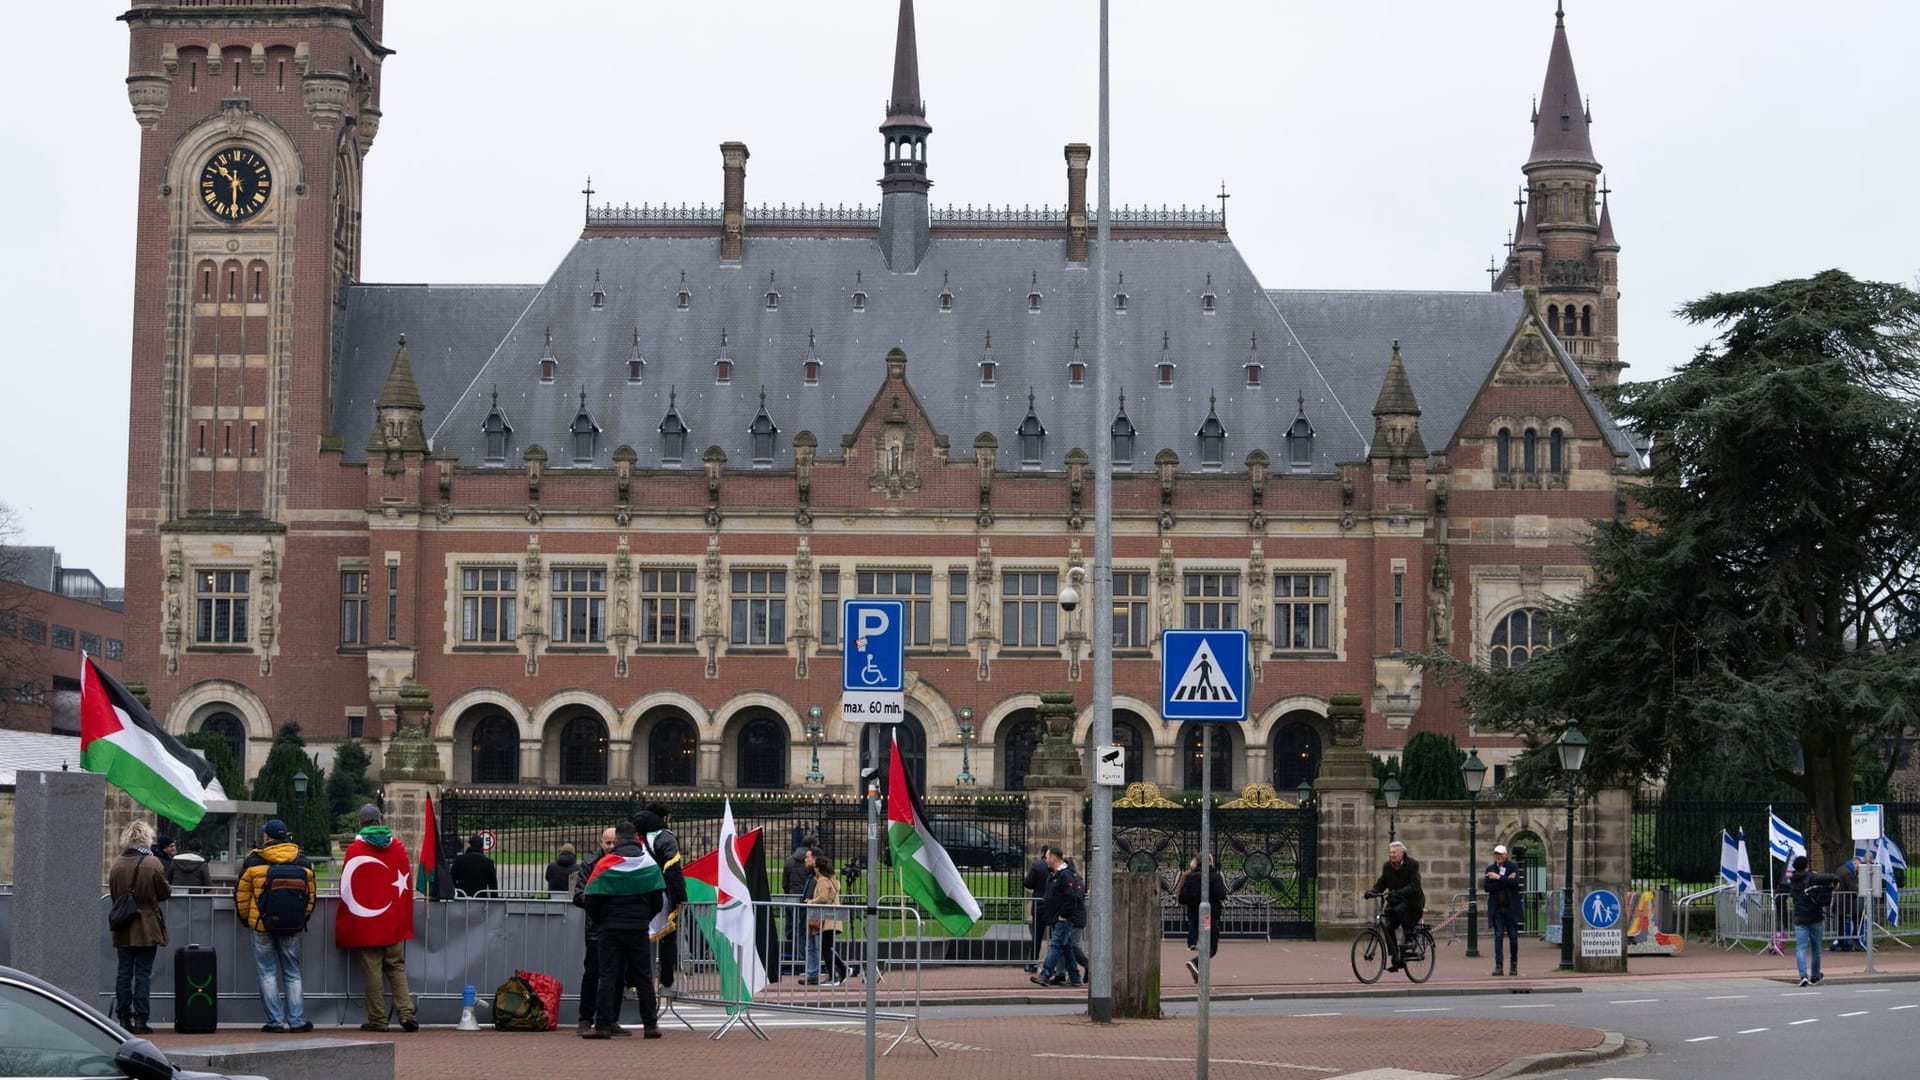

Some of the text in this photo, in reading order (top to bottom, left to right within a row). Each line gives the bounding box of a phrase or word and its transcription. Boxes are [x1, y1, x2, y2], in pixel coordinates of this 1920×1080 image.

[858, 608, 889, 652] P
[843, 701, 902, 714] max. 60 min.
